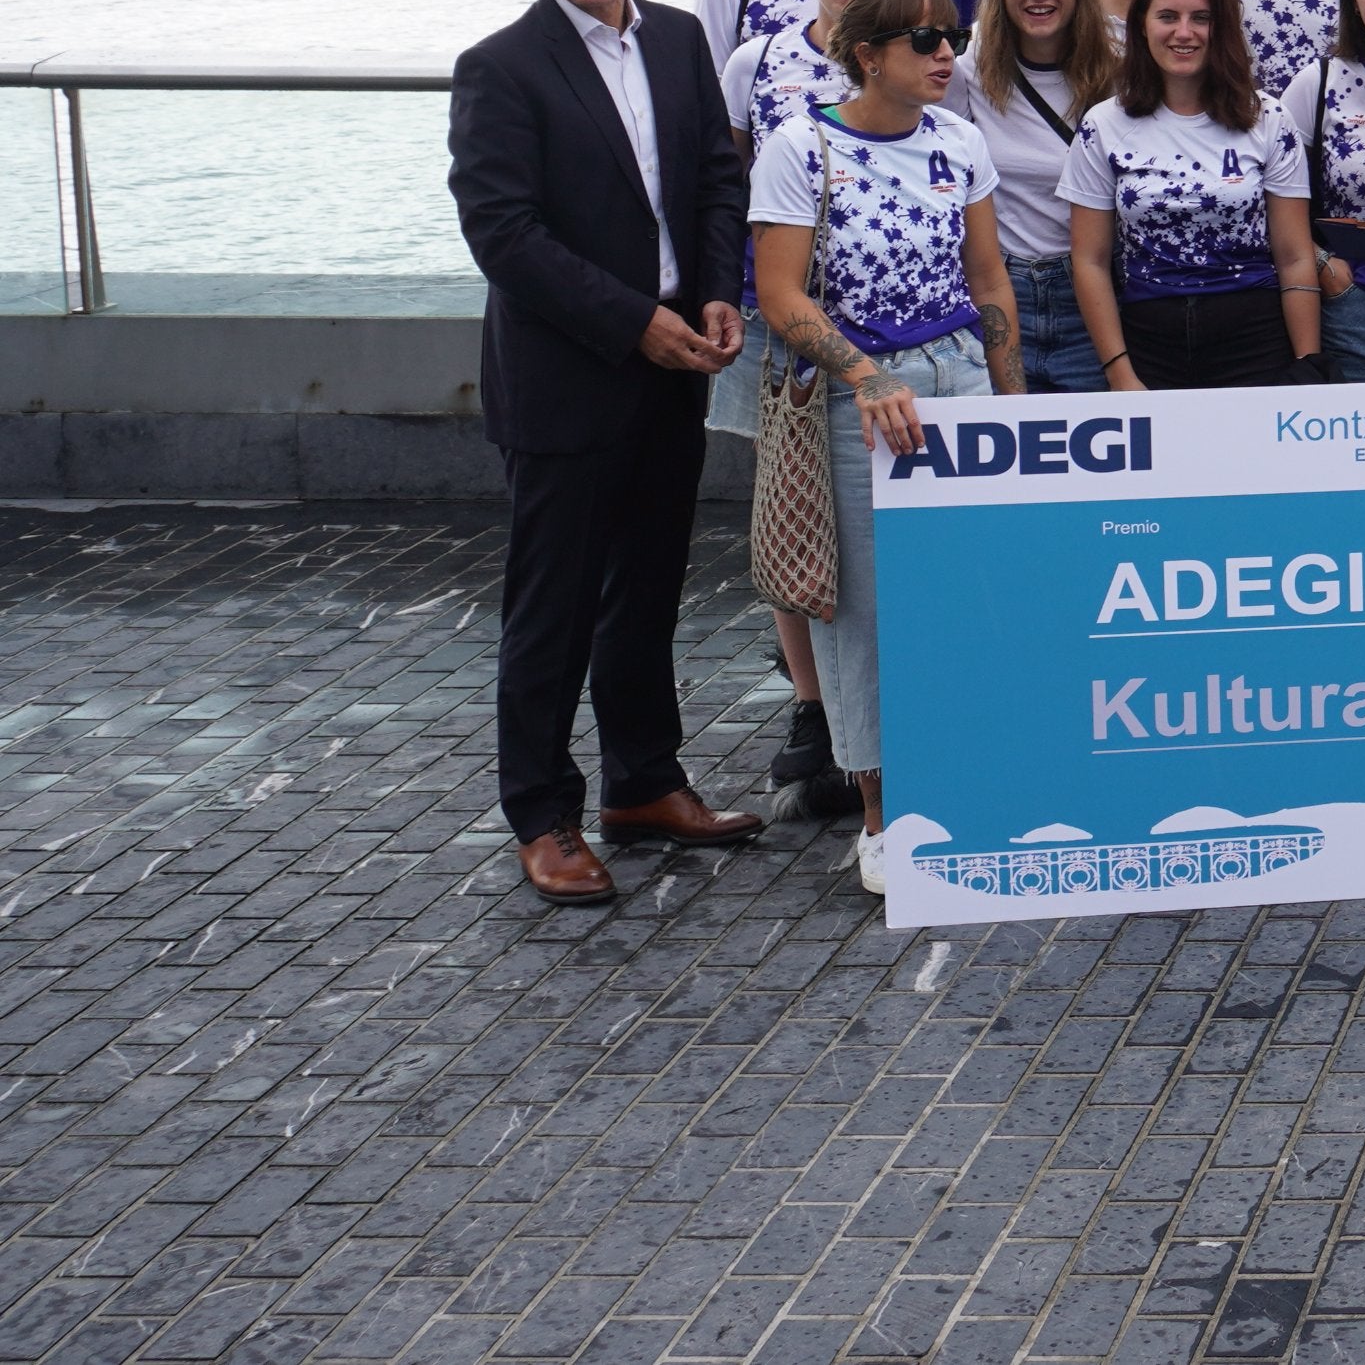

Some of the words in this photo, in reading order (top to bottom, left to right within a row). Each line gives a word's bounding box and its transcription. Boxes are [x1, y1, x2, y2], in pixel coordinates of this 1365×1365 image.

[889, 417, 1152, 479] ADEGI
[1102, 520, 1160, 535] Premio
[1096, 552, 1364, 624] ADEGI
